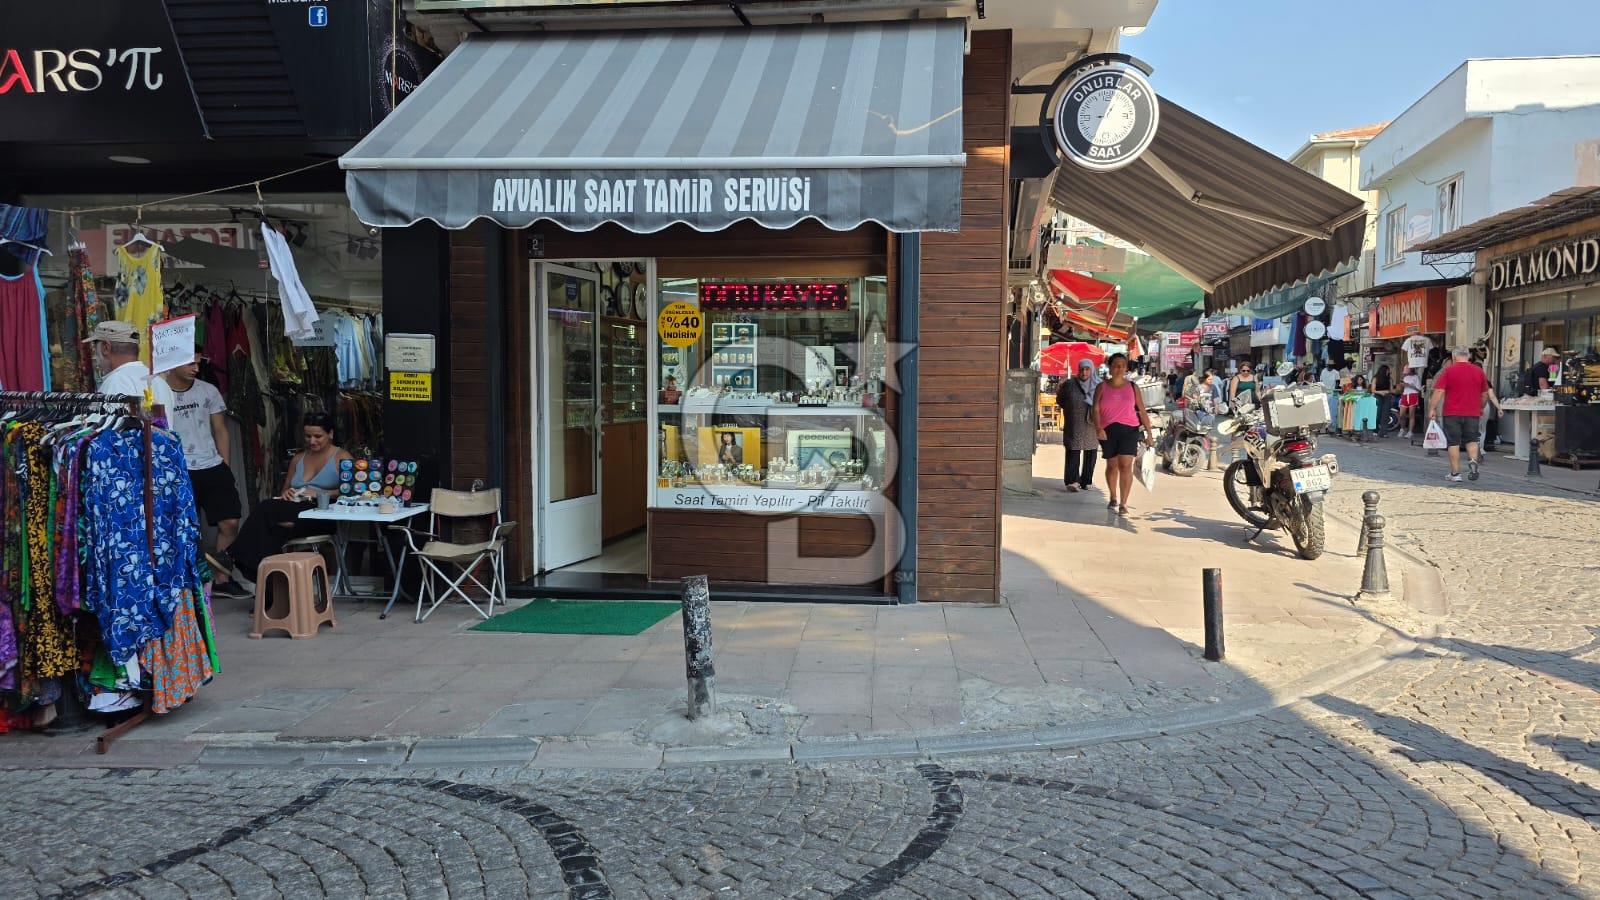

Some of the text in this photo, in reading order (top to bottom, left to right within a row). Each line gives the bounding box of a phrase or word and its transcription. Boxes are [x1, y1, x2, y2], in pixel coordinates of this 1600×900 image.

[1073, 76, 1142, 102] ONURLAR
[1088, 144, 1122, 159] SAAT
[492, 178, 577, 213] AYVALIK
[584, 179, 636, 213] SAAT
[1490, 239, 1600, 291] DIAMOND
[1401, 298, 1422, 323] PARK
[666, 316, 700, 329] %40
[663, 329, 697, 339] İNDİRİM
[674, 493, 705, 506] Saat
[709, 493, 749, 506] Tamiri
[753, 493, 793, 508] Yapılır
[807, 494, 825, 507] Pil
[829, 495, 870, 508] Takılır
